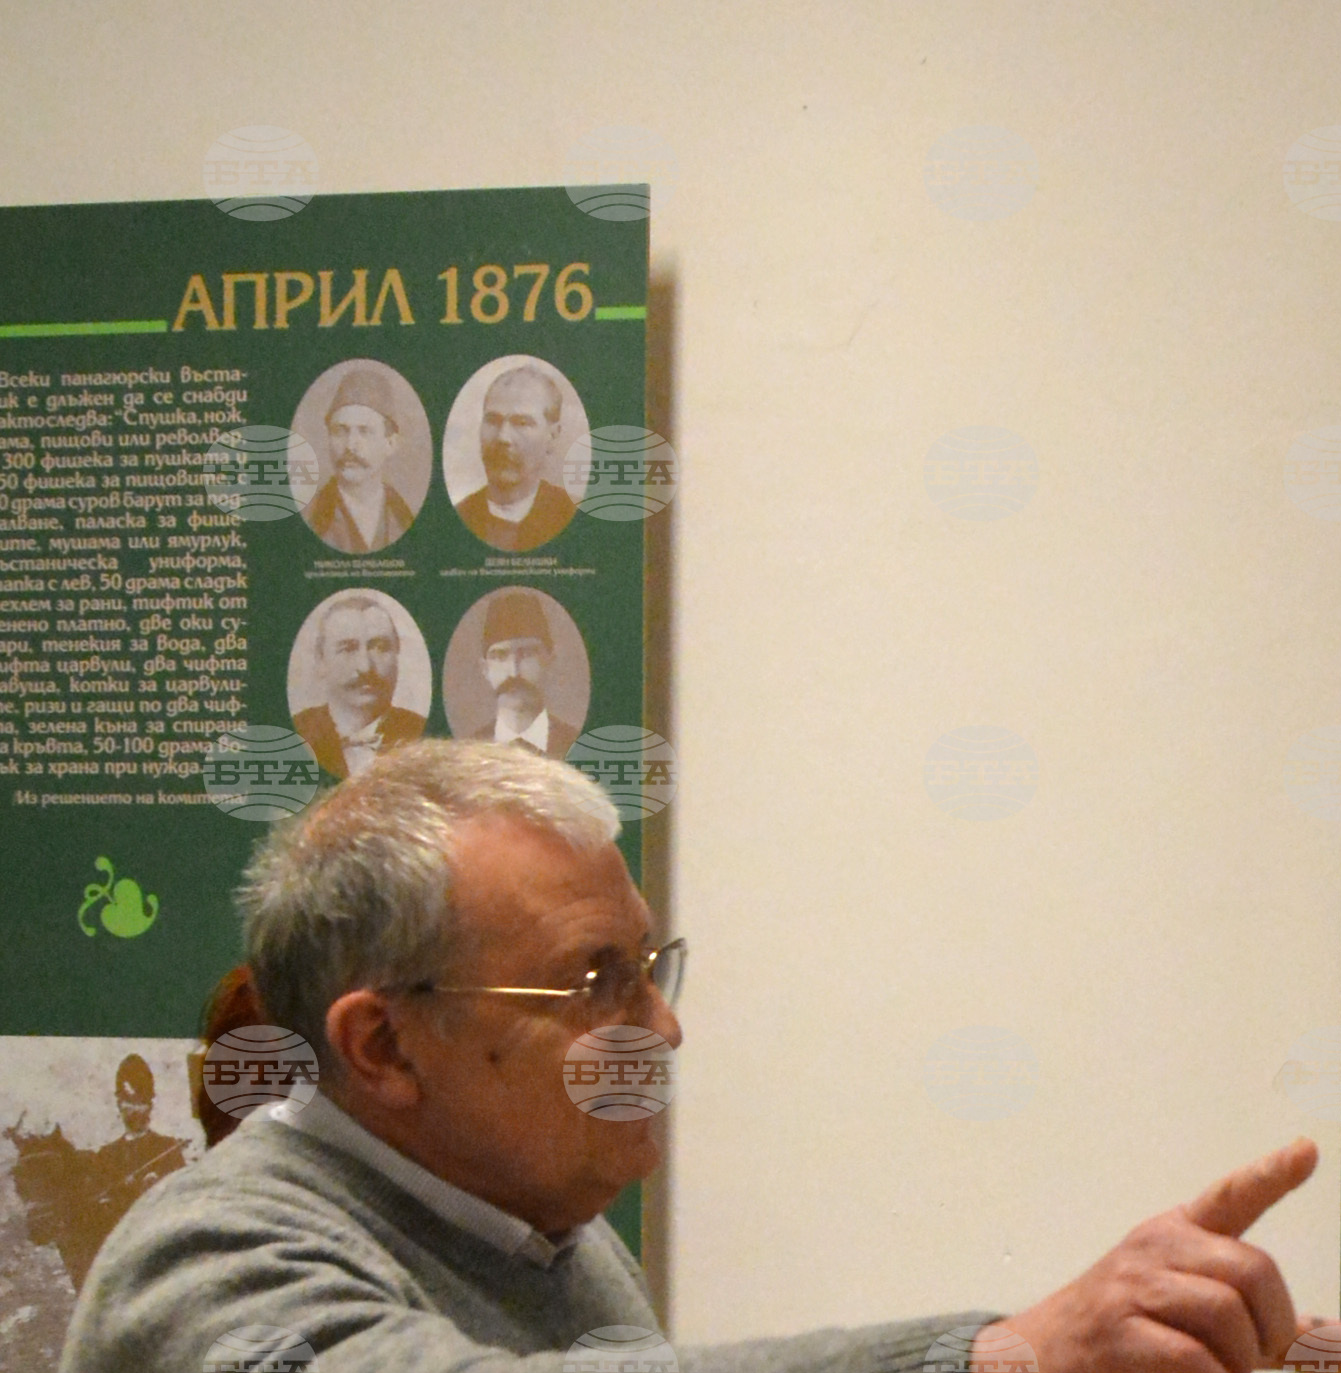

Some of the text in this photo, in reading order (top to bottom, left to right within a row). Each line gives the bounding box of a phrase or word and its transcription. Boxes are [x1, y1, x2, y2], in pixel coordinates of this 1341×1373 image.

[172, 262, 594, 332] АПРИЛ 1876
[61, 367, 170, 389] панагюрски
[180, 365, 247, 385] въста-
[27, 395, 38, 408] е
[46, 390, 114, 412] длъжен
[123, 390, 144, 409] да
[153, 391, 174, 404] се
[182, 387, 247, 406] снабди
[40, 431, 113, 449] пищови
[118, 432, 150, 447] или
[2, 452, 35, 470] 300
[40, 451, 113, 473] фишека
[120, 453, 139, 467] за
[144, 450, 229, 471] пушката
[22, 471, 96, 494] фишека
[101, 474, 120, 488] за
[11, 496, 65, 515] драма
[68, 493, 120, 513] суров
[122, 492, 181, 512] барут
[183, 495, 203, 508] за
[75, 512, 147, 529] паласка
[157, 514, 177, 528] за
[49, 536, 121, 554] мушама
[128, 536, 160, 550] или
[0, 575, 44, 592] апка
[48, 578, 58, 591] с
[100, 574, 122, 590] 50
[125, 576, 180, 593] драма
[184, 572, 247, 592] сладък
[55, 598, 74, 611] за
[133, 593, 214, 614] тифтик
[218, 595, 247, 609] от
[139, 614, 172, 634] две
[180, 614, 213, 630] оки
[42, 636, 121, 653] тенекия
[129, 637, 149, 651] за
[214, 633, 247, 655] два
[143, 655, 176, 675] два
[183, 655, 247, 674] чифта
[69, 675, 130, 692] котки
[138, 679, 157, 692] за
[24, 702, 66, 717] ризи
[71, 702, 82, 713] и
[87, 701, 135, 715] гащи
[139, 700, 162, 713] по
[166, 696, 199, 716] два
[28, 721, 87, 734] зелена
[94, 717, 137, 733] къна
[146, 720, 165, 733] за
[173, 719, 247, 737] спиране
[93, 737, 153, 754] 50-100
[158, 739, 213, 758] драма
[25, 761, 44, 774] за
[48, 761, 99, 778] храна
[105, 761, 138, 778] при
[136, 793, 153, 804] на
